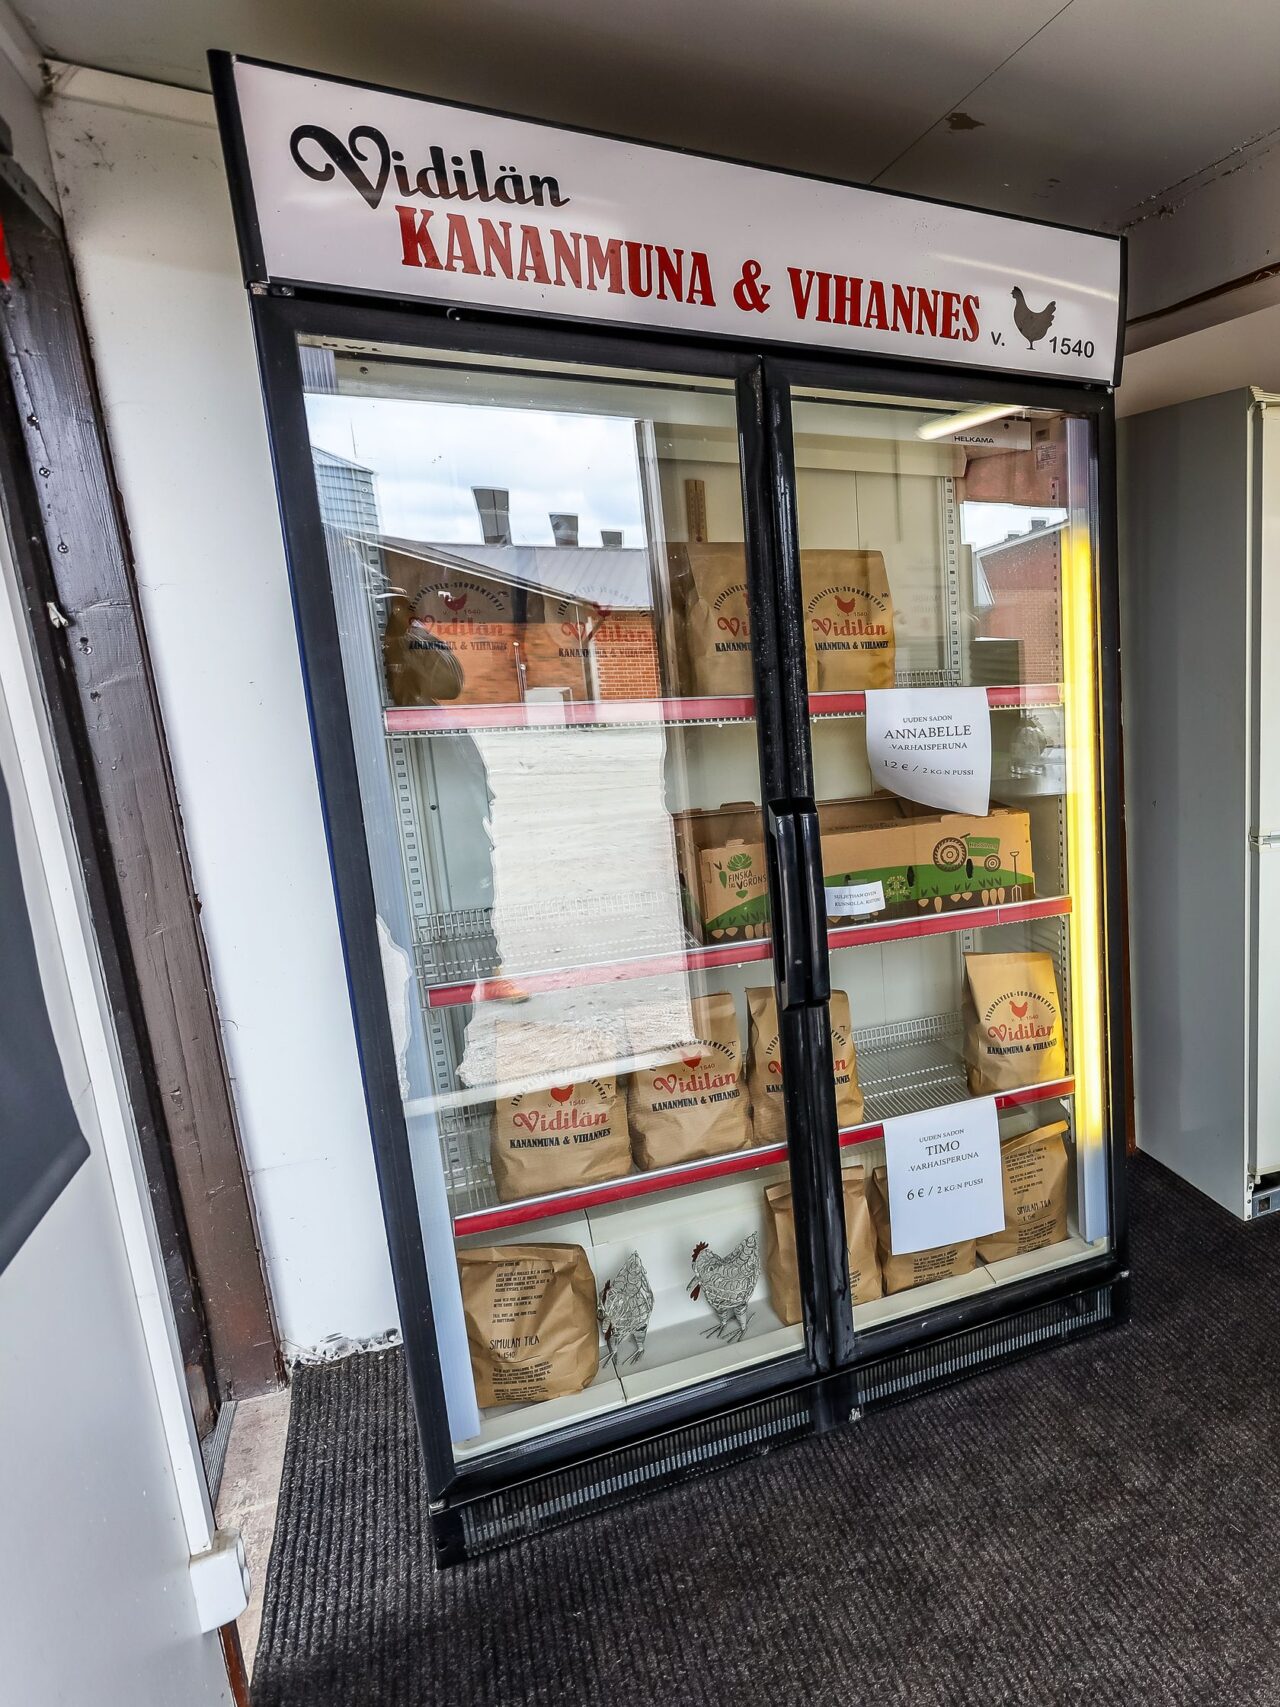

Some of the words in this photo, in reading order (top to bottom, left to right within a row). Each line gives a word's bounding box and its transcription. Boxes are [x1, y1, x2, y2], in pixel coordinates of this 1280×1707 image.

[289, 124, 570, 210] Vidilän
[395, 205, 716, 309] KANANMUNA
[733, 259, 770, 312] &
[788, 266, 981, 343] VIHANNES
[990, 331, 1006, 348] v.
[1048, 336, 1096, 360] 1540
[954, 436, 994, 444] HELKAMA
[811, 617, 888, 636] Vidilän
[815, 642, 850, 651] ANANMUNA
[929, 714, 953, 722] SADON
[884, 724, 972, 740] ANNABELLE
[884, 760, 898, 769] 12
[901, 763, 909, 771] €
[728, 870, 752, 882] FINSKA
[653, 1072, 737, 1094] Vidilän
[652, 1097, 698, 1112] KANANMUNA
[700, 1096, 707, 1105] &
[512, 1108, 610, 1133] Vidilän
[510, 1137, 560, 1149] KANANMUNA
[563, 1136, 570, 1145] &
[573, 1127, 611, 1144] VIHANNES
[919, 1134, 941, 1142] UUDEN
[943, 1128, 964, 1138] SADON
[925, 1140, 960, 1155] TIMO
[907, 1189, 914, 1200] 6
[918, 1187, 924, 1198] €
[964, 1178, 983, 1188] PUSSI
[490, 1337, 520, 1350] SIMULAN
[524, 1335, 539, 1346] TILA
